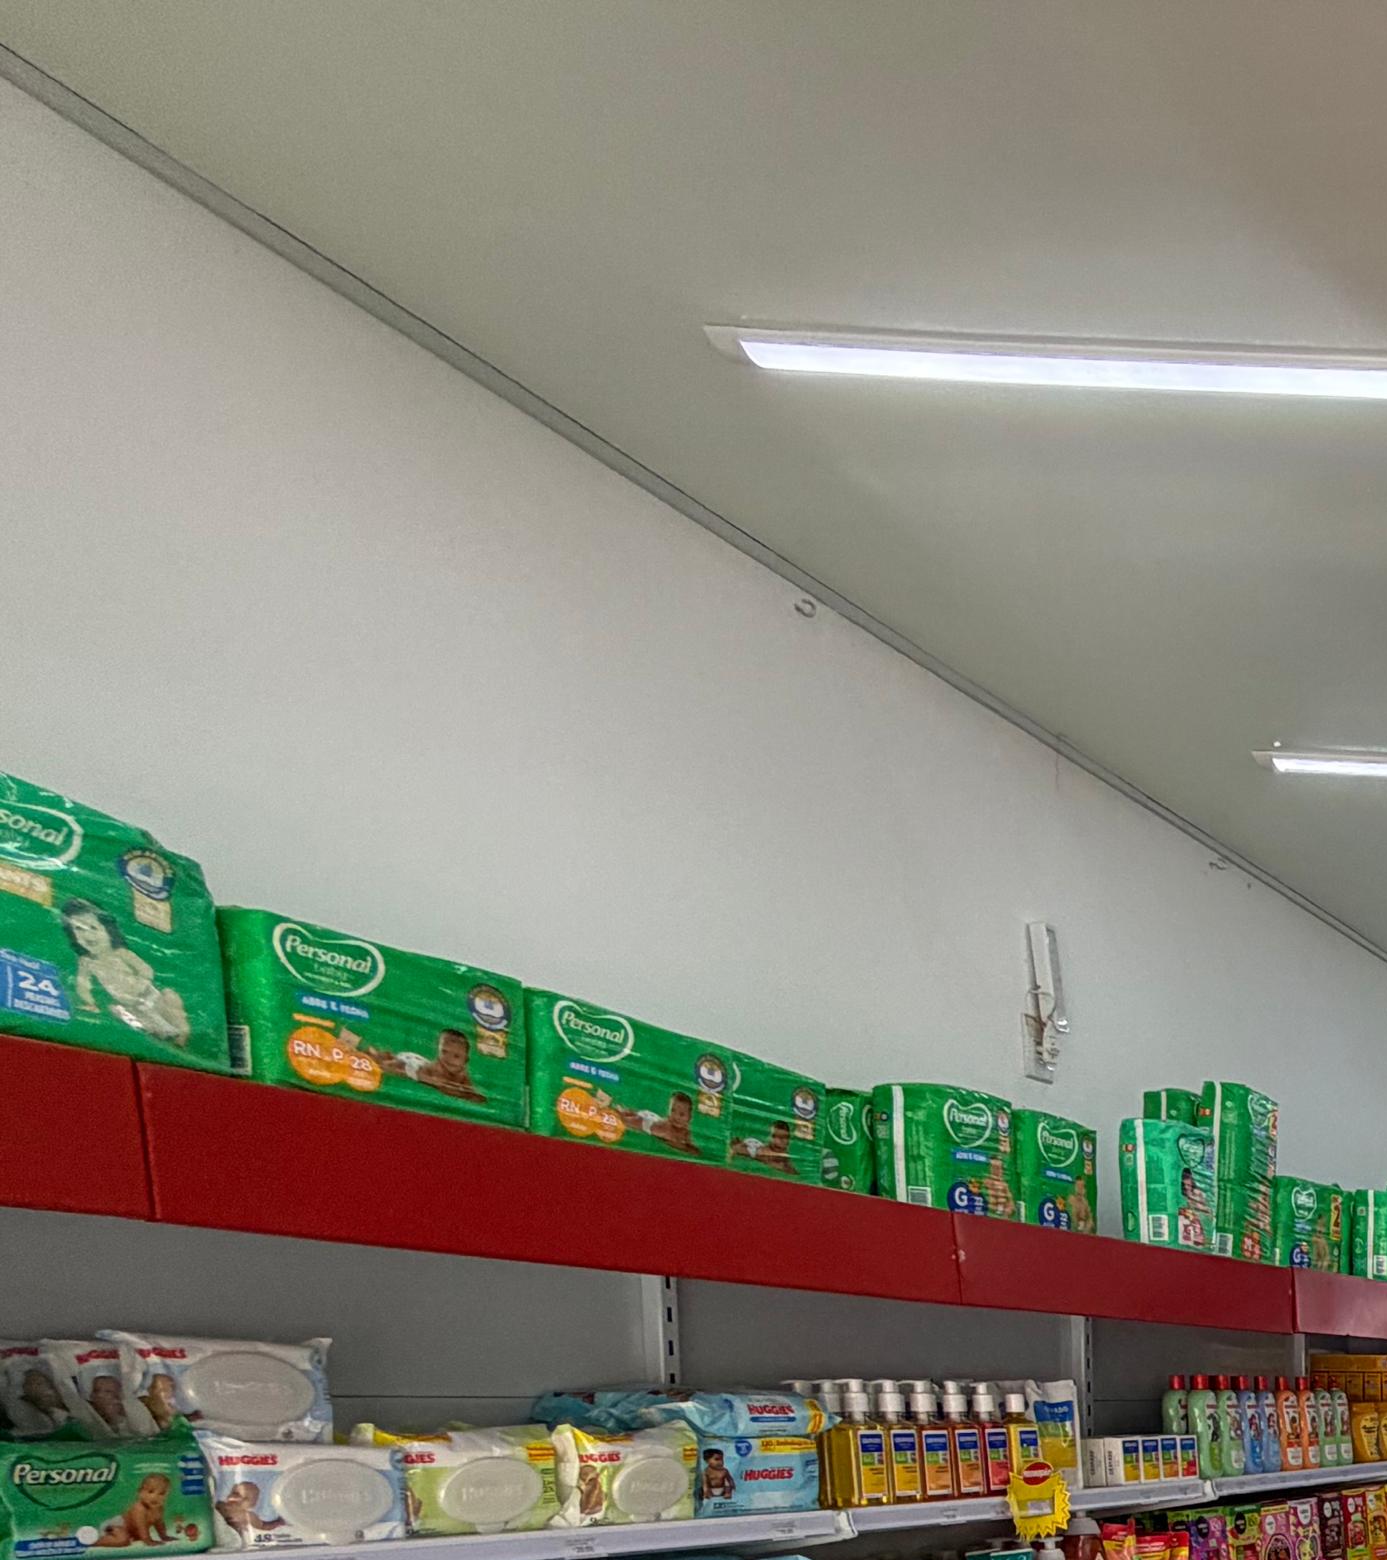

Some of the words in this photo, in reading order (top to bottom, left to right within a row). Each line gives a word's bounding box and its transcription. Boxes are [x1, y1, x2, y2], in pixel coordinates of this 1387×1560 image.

[0, 808, 69, 846] sonal
[285, 934, 372, 974] Personal
[561, 1011, 625, 1043] Personal
[949, 1108, 989, 1127] Personal
[1041, 1130, 1074, 1149] Personal
[218, 1454, 279, 1468] HUGGIES
[13, 1461, 118, 1486] Personal
[743, 1468, 794, 1481] HUGGIES
